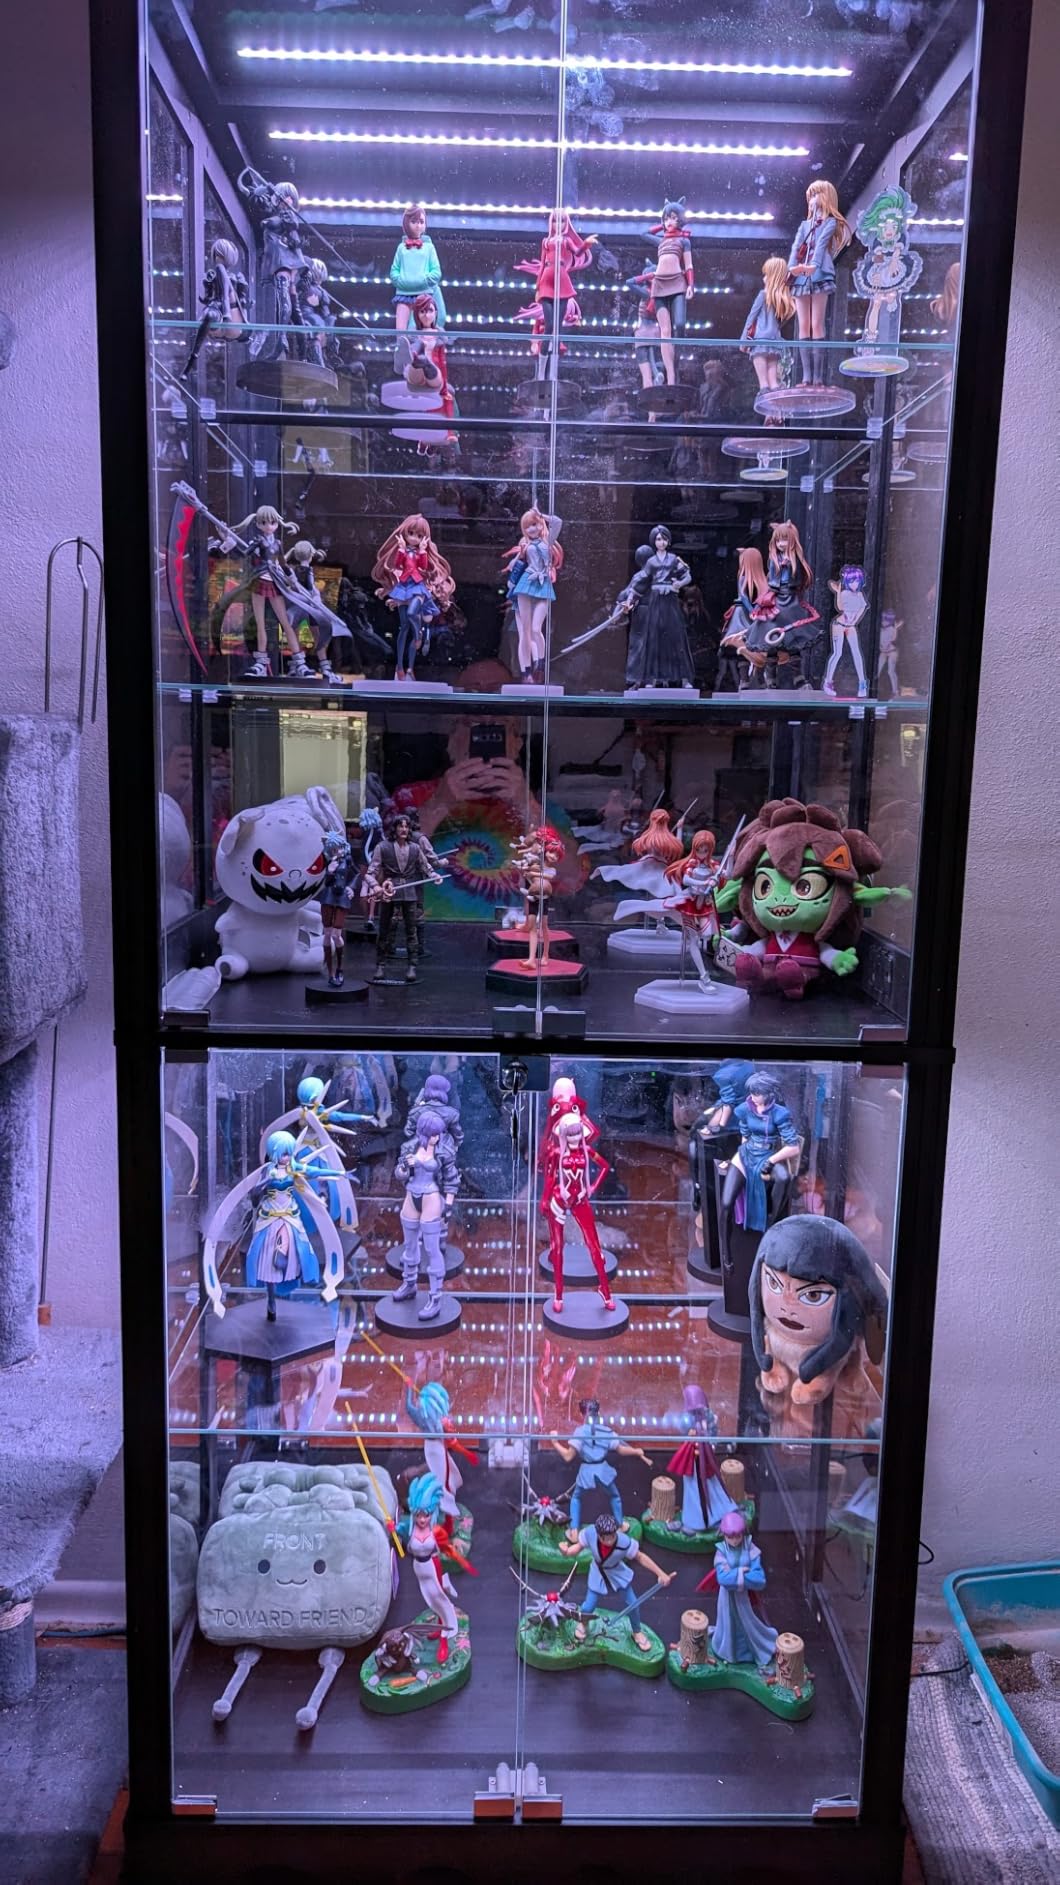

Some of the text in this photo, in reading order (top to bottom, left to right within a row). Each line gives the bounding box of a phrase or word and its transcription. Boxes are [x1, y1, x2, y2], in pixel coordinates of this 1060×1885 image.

[263, 1533, 327, 1550] FRONT
[213, 1607, 368, 1628] TOWARD FRIEND
